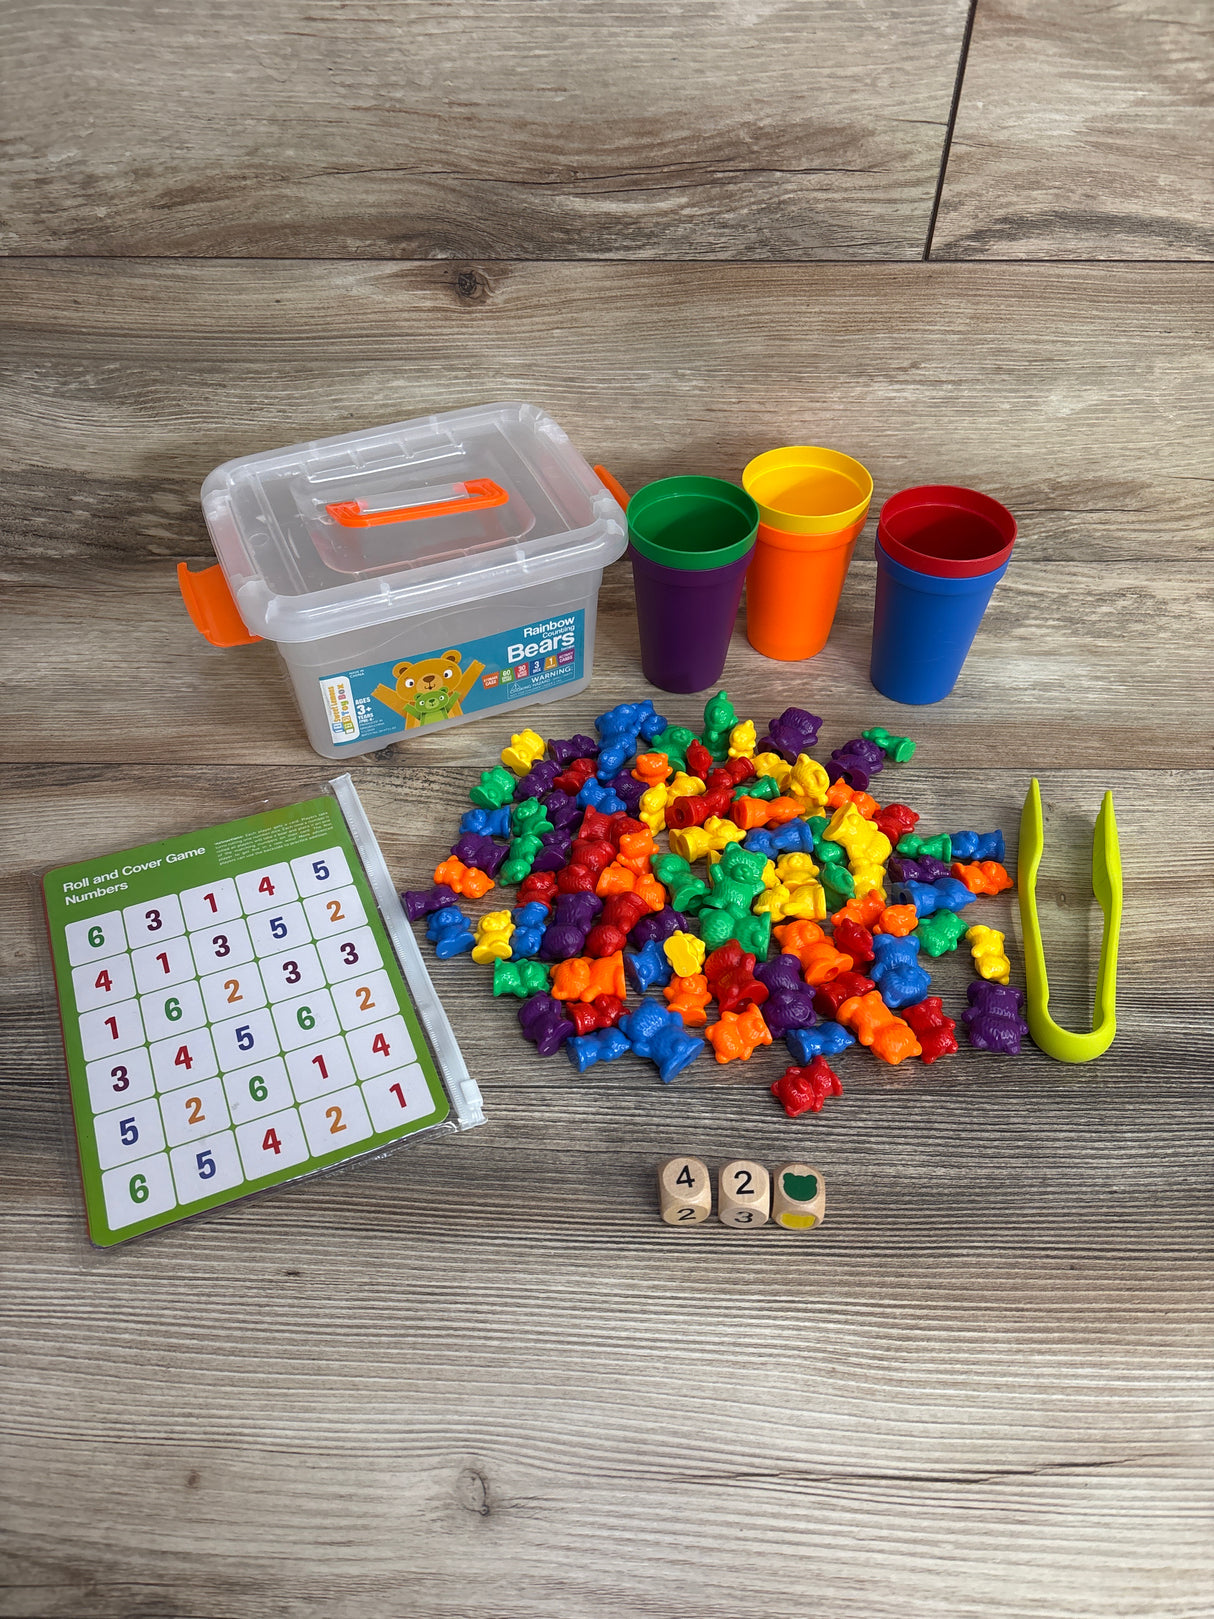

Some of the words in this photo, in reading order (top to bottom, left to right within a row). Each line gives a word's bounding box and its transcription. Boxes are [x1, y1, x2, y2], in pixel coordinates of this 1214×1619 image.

[523, 617, 575, 638] Rainbow
[543, 625, 575, 639] Counting
[507, 632, 575, 663] Bears
[534, 661, 540, 669] 3
[337, 683, 346, 700] Box
[355, 697, 371, 705] AGES
[331, 706, 341, 722] Sweet
[341, 700, 349, 716] Toy
[356, 704, 372, 715] 3+
[63, 877, 90, 893] Roll
[93, 869, 119, 885] and
[122, 858, 162, 876] Cover
[165, 847, 206, 864] Game
[65, 881, 129, 906] Numbers
[87, 925, 105, 947] 6
[145, 909, 163, 931] 3
[203, 892, 218, 913] 1
[258, 876, 276, 895] 4
[311, 859, 330, 880] 5
[94, 969, 113, 992] 4
[155, 951, 171, 973] 1
[212, 934, 231, 957] 3
[269, 916, 288, 939] 5
[326, 900, 345, 922] 2
[103, 1015, 120, 1039] 1
[164, 997, 183, 1021] 6
[223, 979, 244, 1003] 2
[282, 960, 302, 983] 3
[339, 942, 359, 965] 3
[110, 1065, 130, 1092] 3
[174, 1045, 194, 1069] 4
[235, 1024, 255, 1050] 5
[296, 1005, 316, 1030] 6
[355, 986, 376, 1010] 2
[119, 1116, 139, 1145] 5
[185, 1096, 206, 1124] 2
[248, 1075, 269, 1101] 6
[311, 1054, 329, 1079] 1
[371, 1032, 391, 1056] 4
[128, 1173, 150, 1203] 6
[195, 1149, 217, 1179] 5
[261, 1127, 282, 1154] 4
[325, 1106, 347, 1134] 2
[388, 1082, 408, 1108] 1
[675, 1164, 695, 1188] 4
[733, 1170, 755, 1195] 2
[676, 1208, 697, 1221] 2
[734, 1211, 754, 1223] 3
